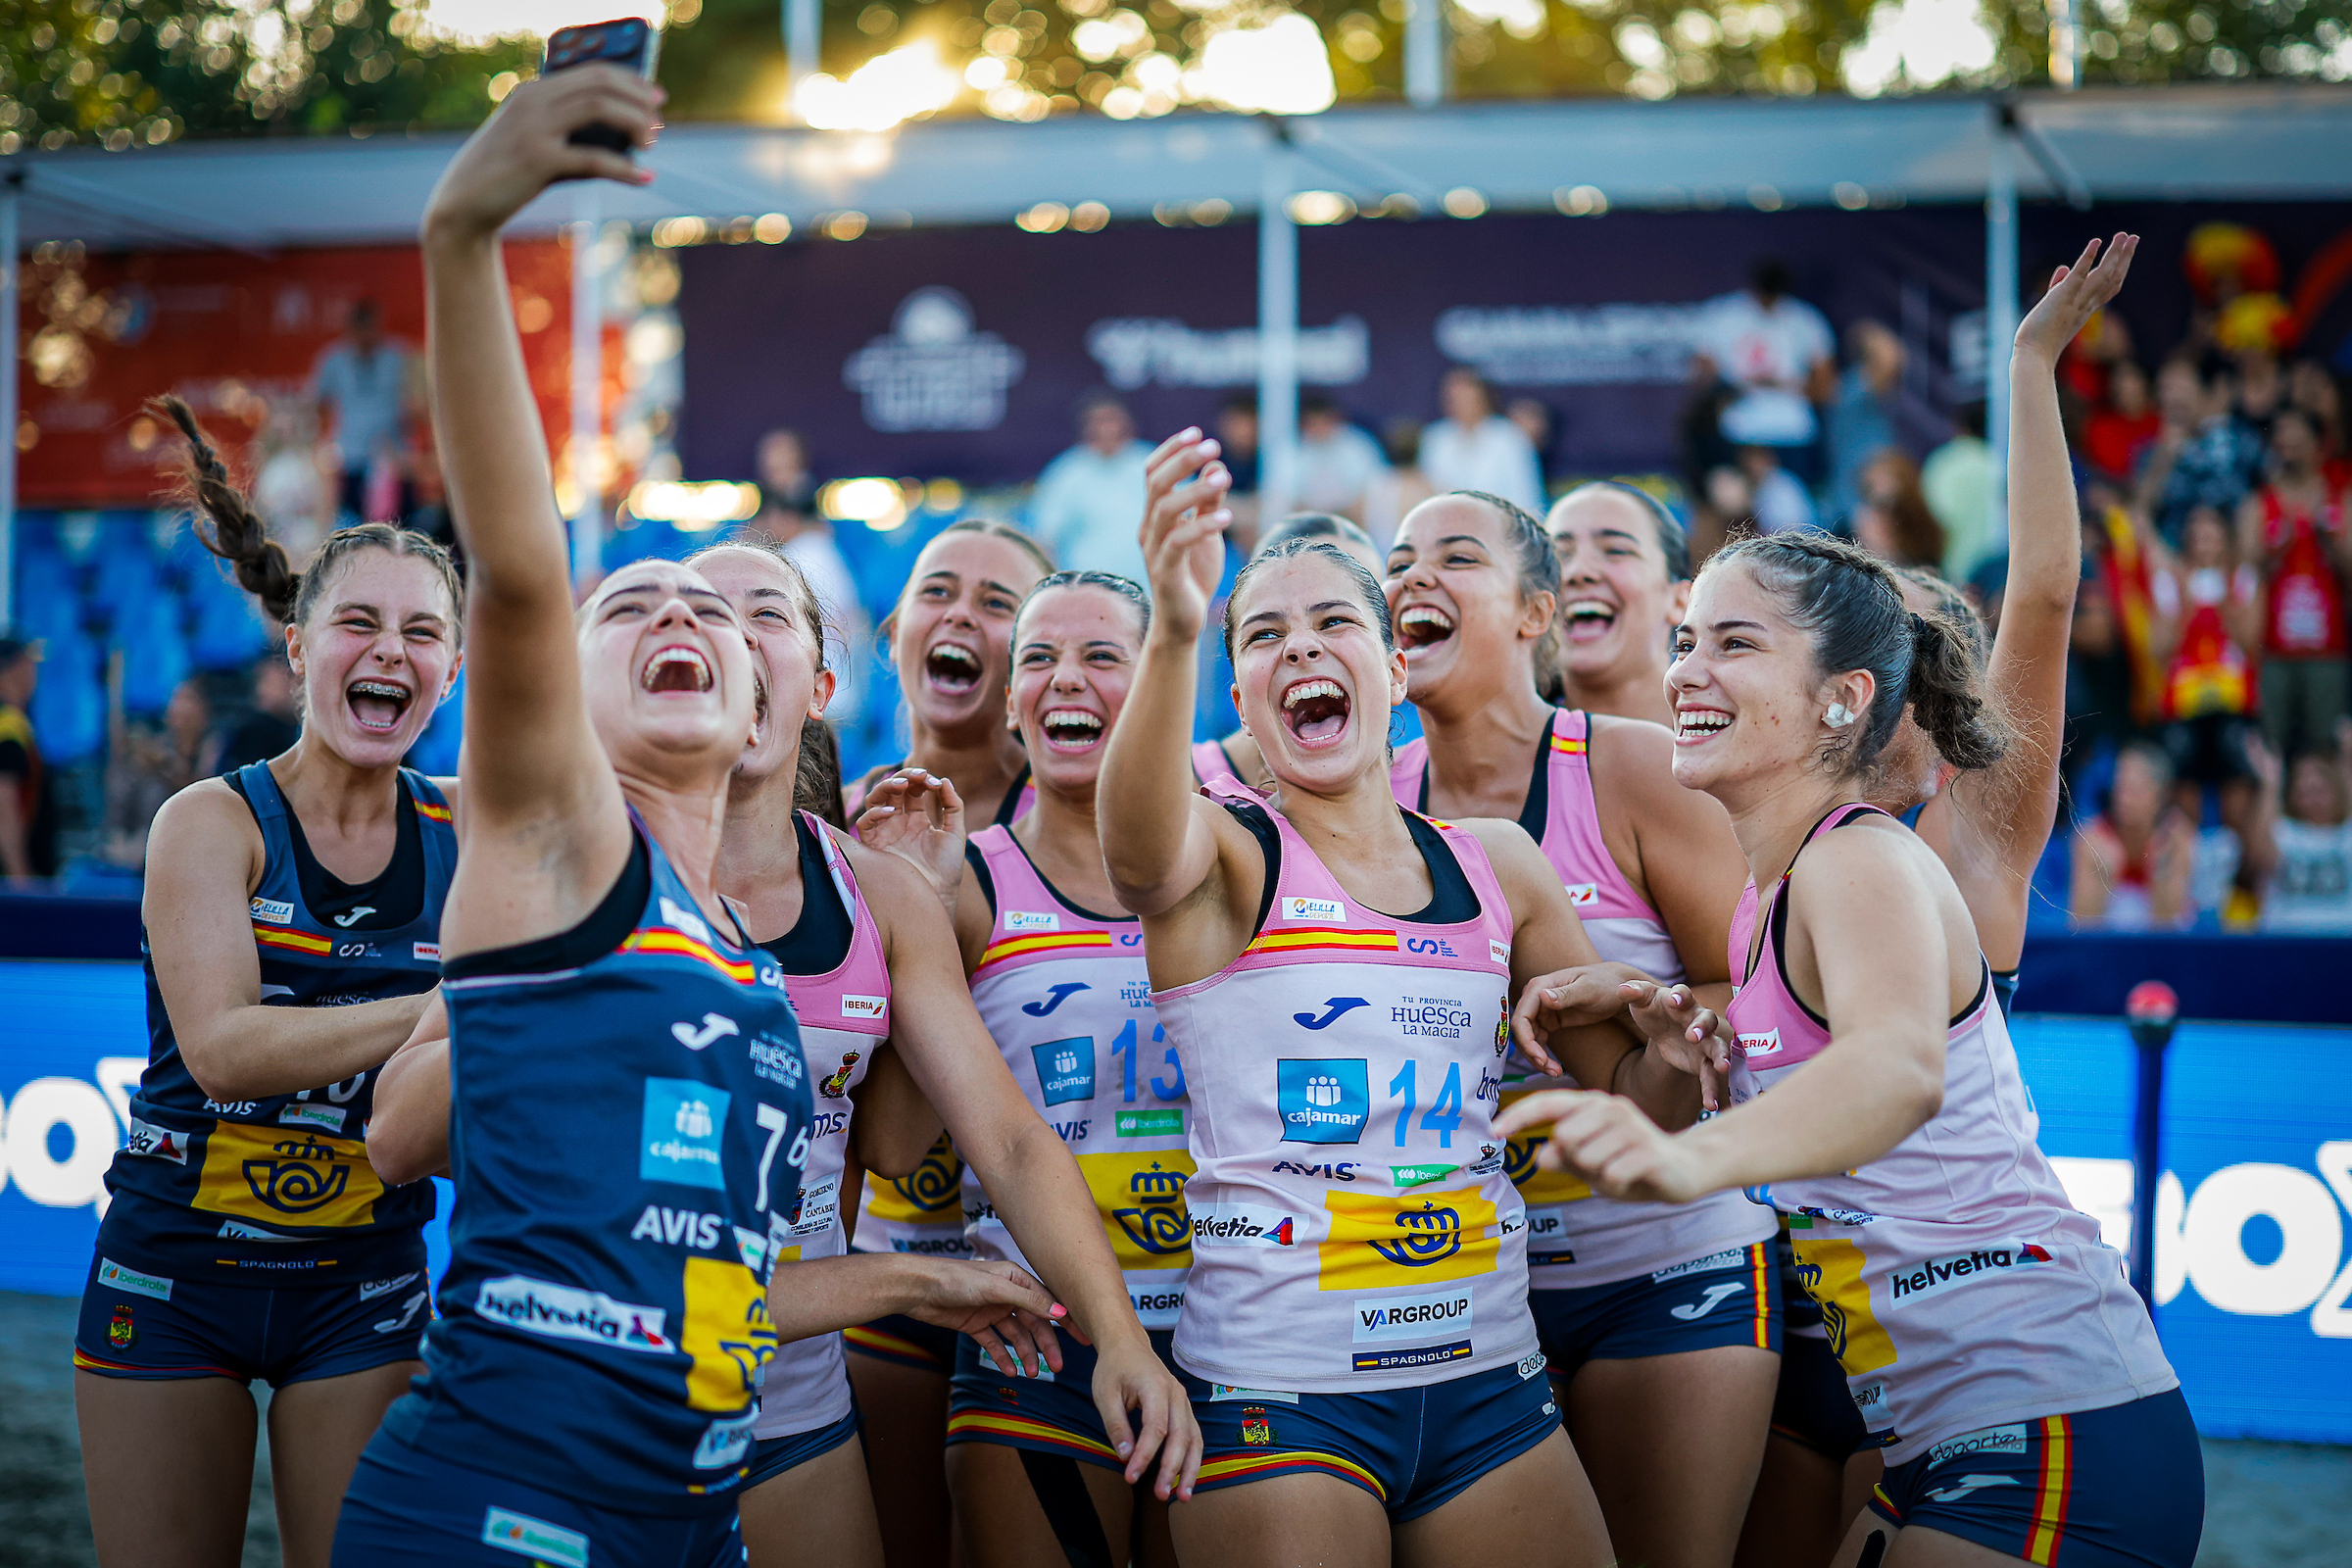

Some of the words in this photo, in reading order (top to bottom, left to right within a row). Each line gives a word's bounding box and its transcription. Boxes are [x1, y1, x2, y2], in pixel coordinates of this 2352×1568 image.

[845, 1001, 873, 1011] IBERIA
[1391, 1005, 1472, 1028] Huesca
[1742, 1039, 1768, 1049] ERIA
[1111, 1019, 1188, 1102] 13
[1046, 1073, 1092, 1092] cajamar
[202, 1098, 257, 1116] AVIS
[1389, 1059, 1462, 1149] 14
[1287, 1107, 1362, 1128] cajamar
[1050, 1119, 1088, 1142] VIS
[649, 1137, 720, 1165] cajamar
[755, 1102, 788, 1213] 7
[1271, 1160, 1356, 1182] AVIS
[808, 1182, 834, 1200] GOBIERNO
[631, 1204, 723, 1250] AVIS
[239, 1259, 314, 1270] SPAGNOLO
[1891, 1250, 2012, 1299] helvetia
[483, 1291, 621, 1341] helvetia
[1360, 1298, 1469, 1331] VARGROUP
[1380, 1349, 1451, 1368] SPAGNOLO
